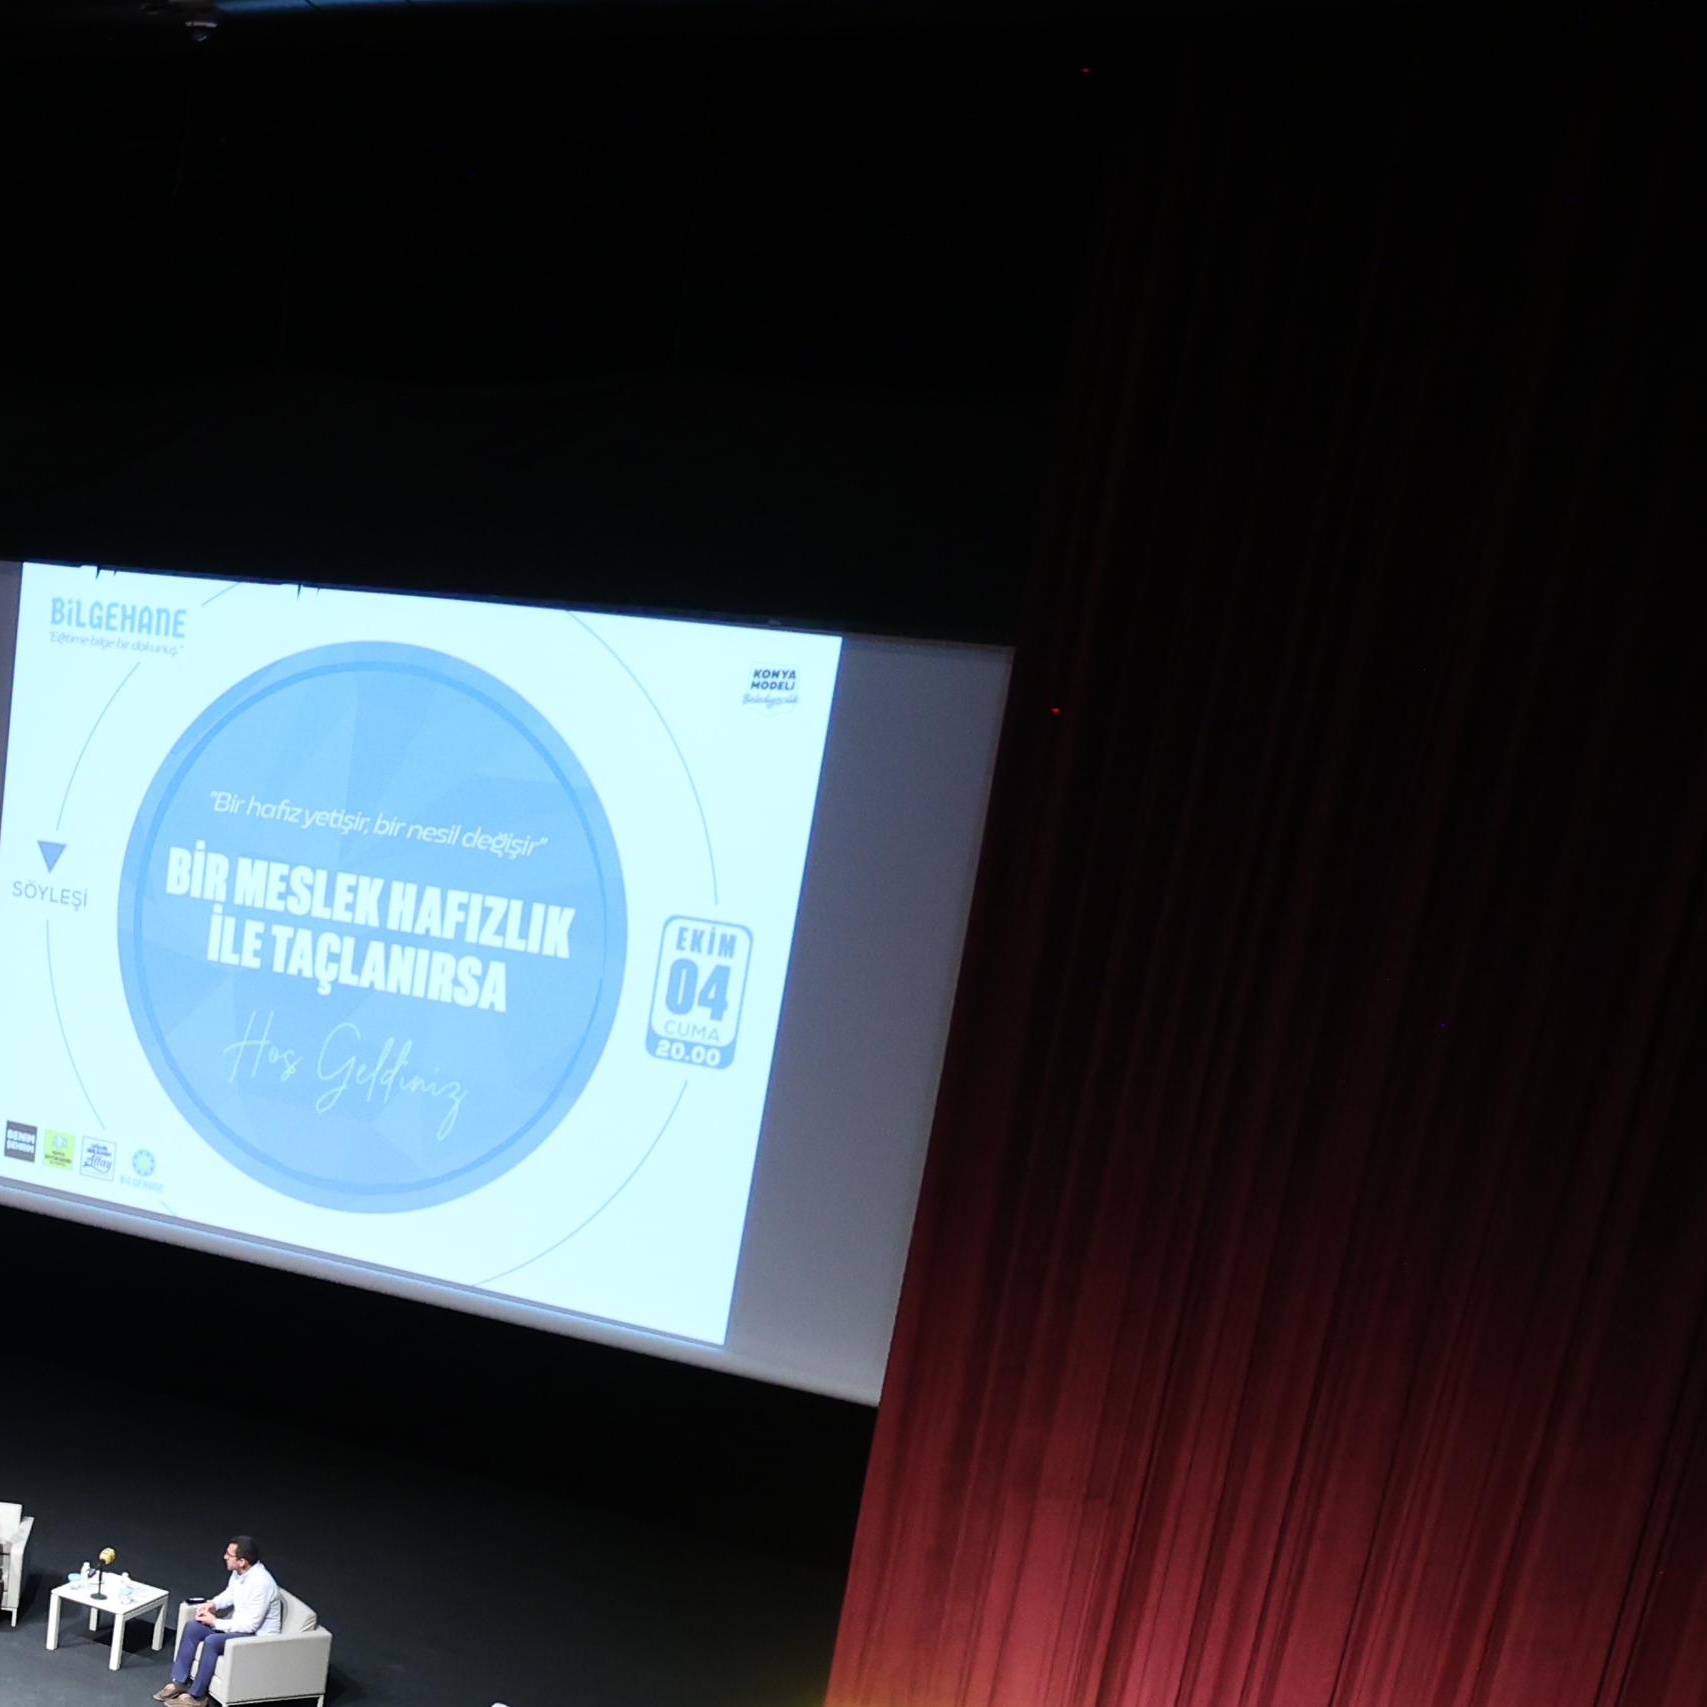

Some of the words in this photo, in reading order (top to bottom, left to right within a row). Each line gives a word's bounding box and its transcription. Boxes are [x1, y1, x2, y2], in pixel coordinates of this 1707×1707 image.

[752, 668, 796, 680] KONYA
[246, 796, 299, 823] hafız
[374, 812, 408, 837] bir
[407, 820, 461, 848] nesil
[12, 879, 88, 912] SÖYLEŞİ
[166, 840, 230, 902] BİR
[233, 857, 385, 927] MESLEK
[386, 880, 576, 959] HAFIZLIK
[207, 902, 266, 969] İLE
[271, 922, 507, 1012] TAÇLANIRSA
[676, 925, 737, 959] EKİM
[665, 957, 732, 1022] 04
[663, 1019, 720, 1042] CUMA
[655, 1038, 722, 1067] 20.00
